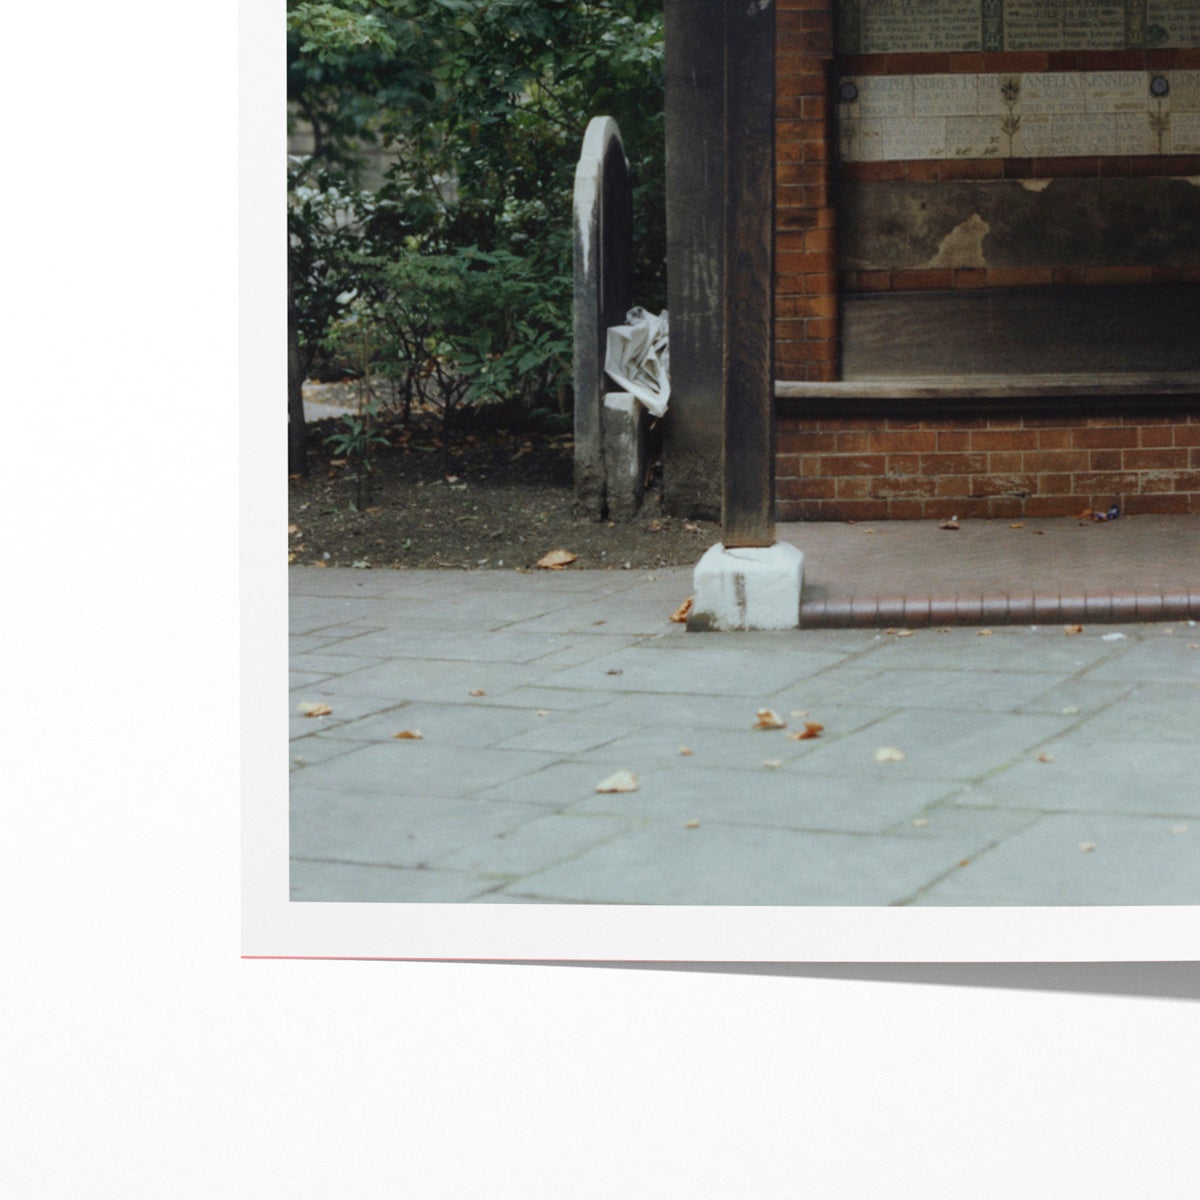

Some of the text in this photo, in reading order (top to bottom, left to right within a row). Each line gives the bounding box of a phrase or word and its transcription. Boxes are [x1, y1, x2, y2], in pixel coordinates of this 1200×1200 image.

[1034, 9, 1059, 18] JULY
[861, 78, 906, 91] JOSEPH
[962, 75, 1001, 89] FORD
[1025, 72, 1145, 88] AMELIA KENNEDY
